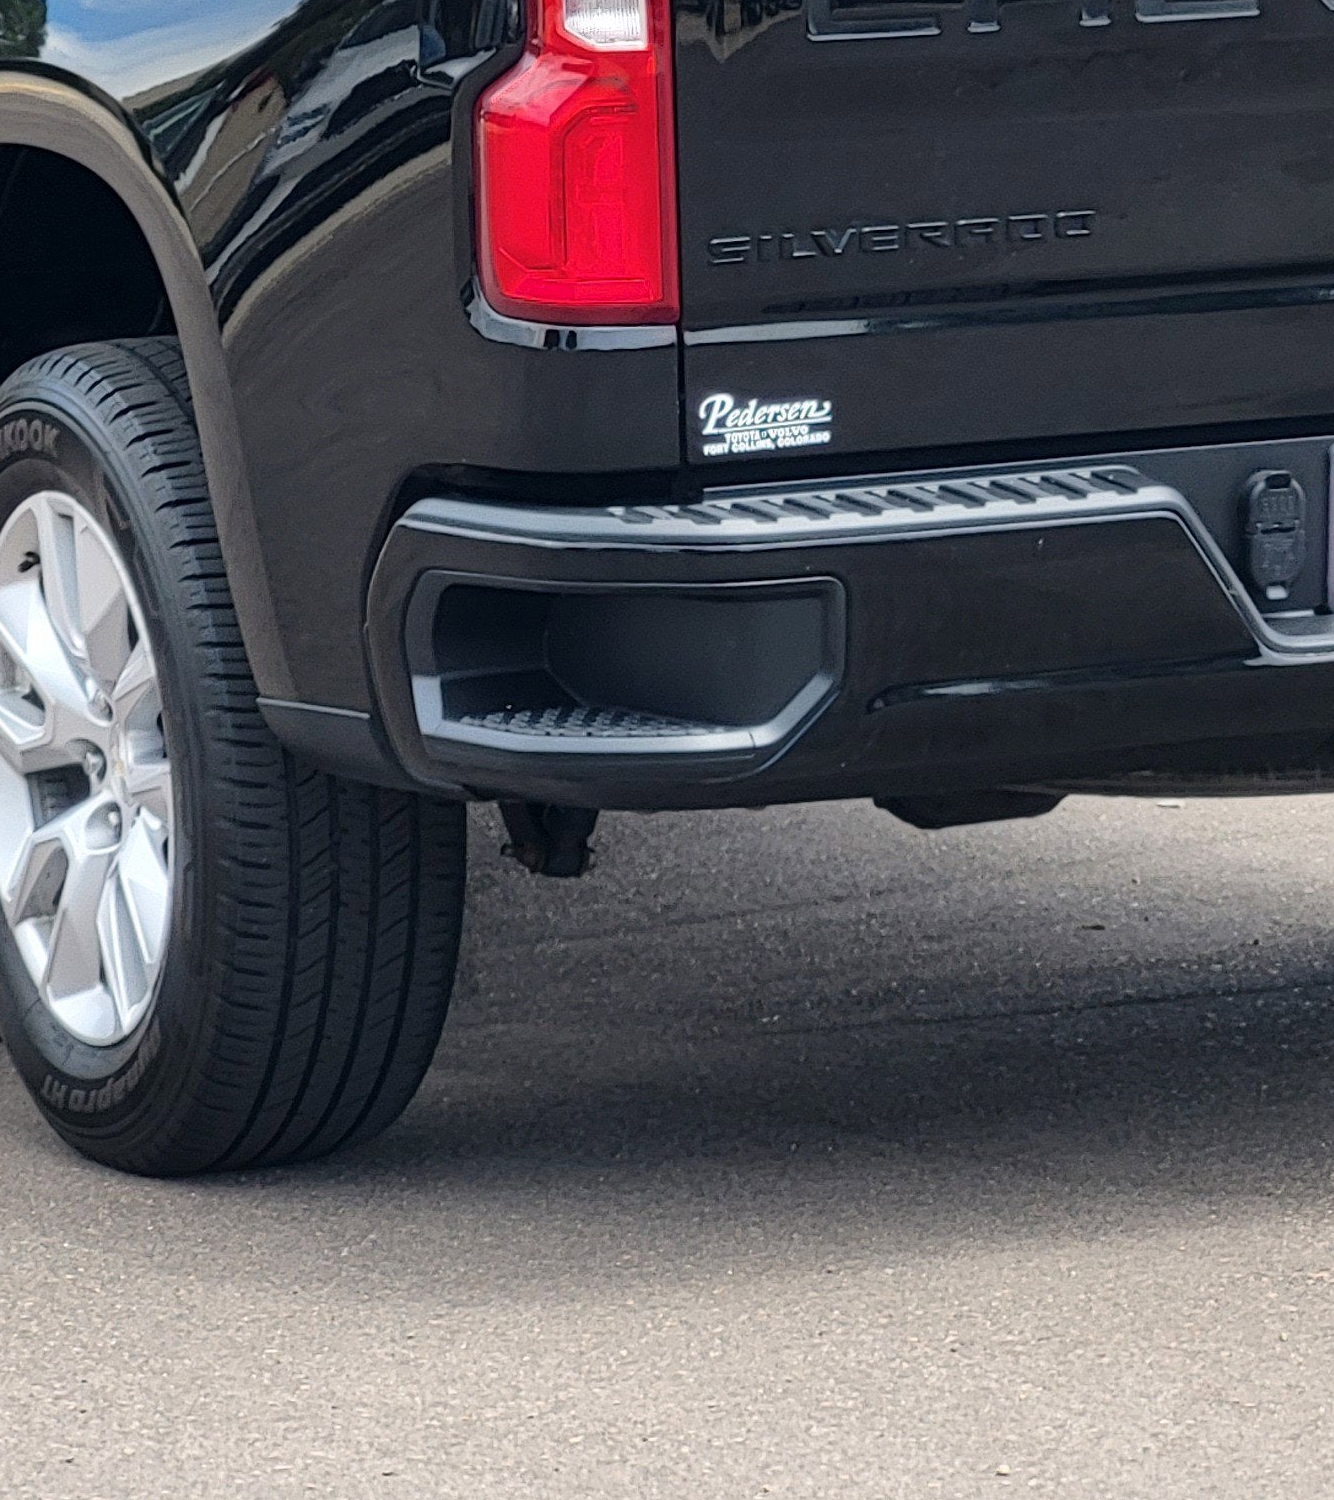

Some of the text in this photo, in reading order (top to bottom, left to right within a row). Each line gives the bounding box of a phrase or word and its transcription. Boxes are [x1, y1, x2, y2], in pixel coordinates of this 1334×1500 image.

[707, 209, 1098, 265] SILVERADO
[698, 393, 833, 435] Pedersen
[768, 425, 810, 438] VOLVO
